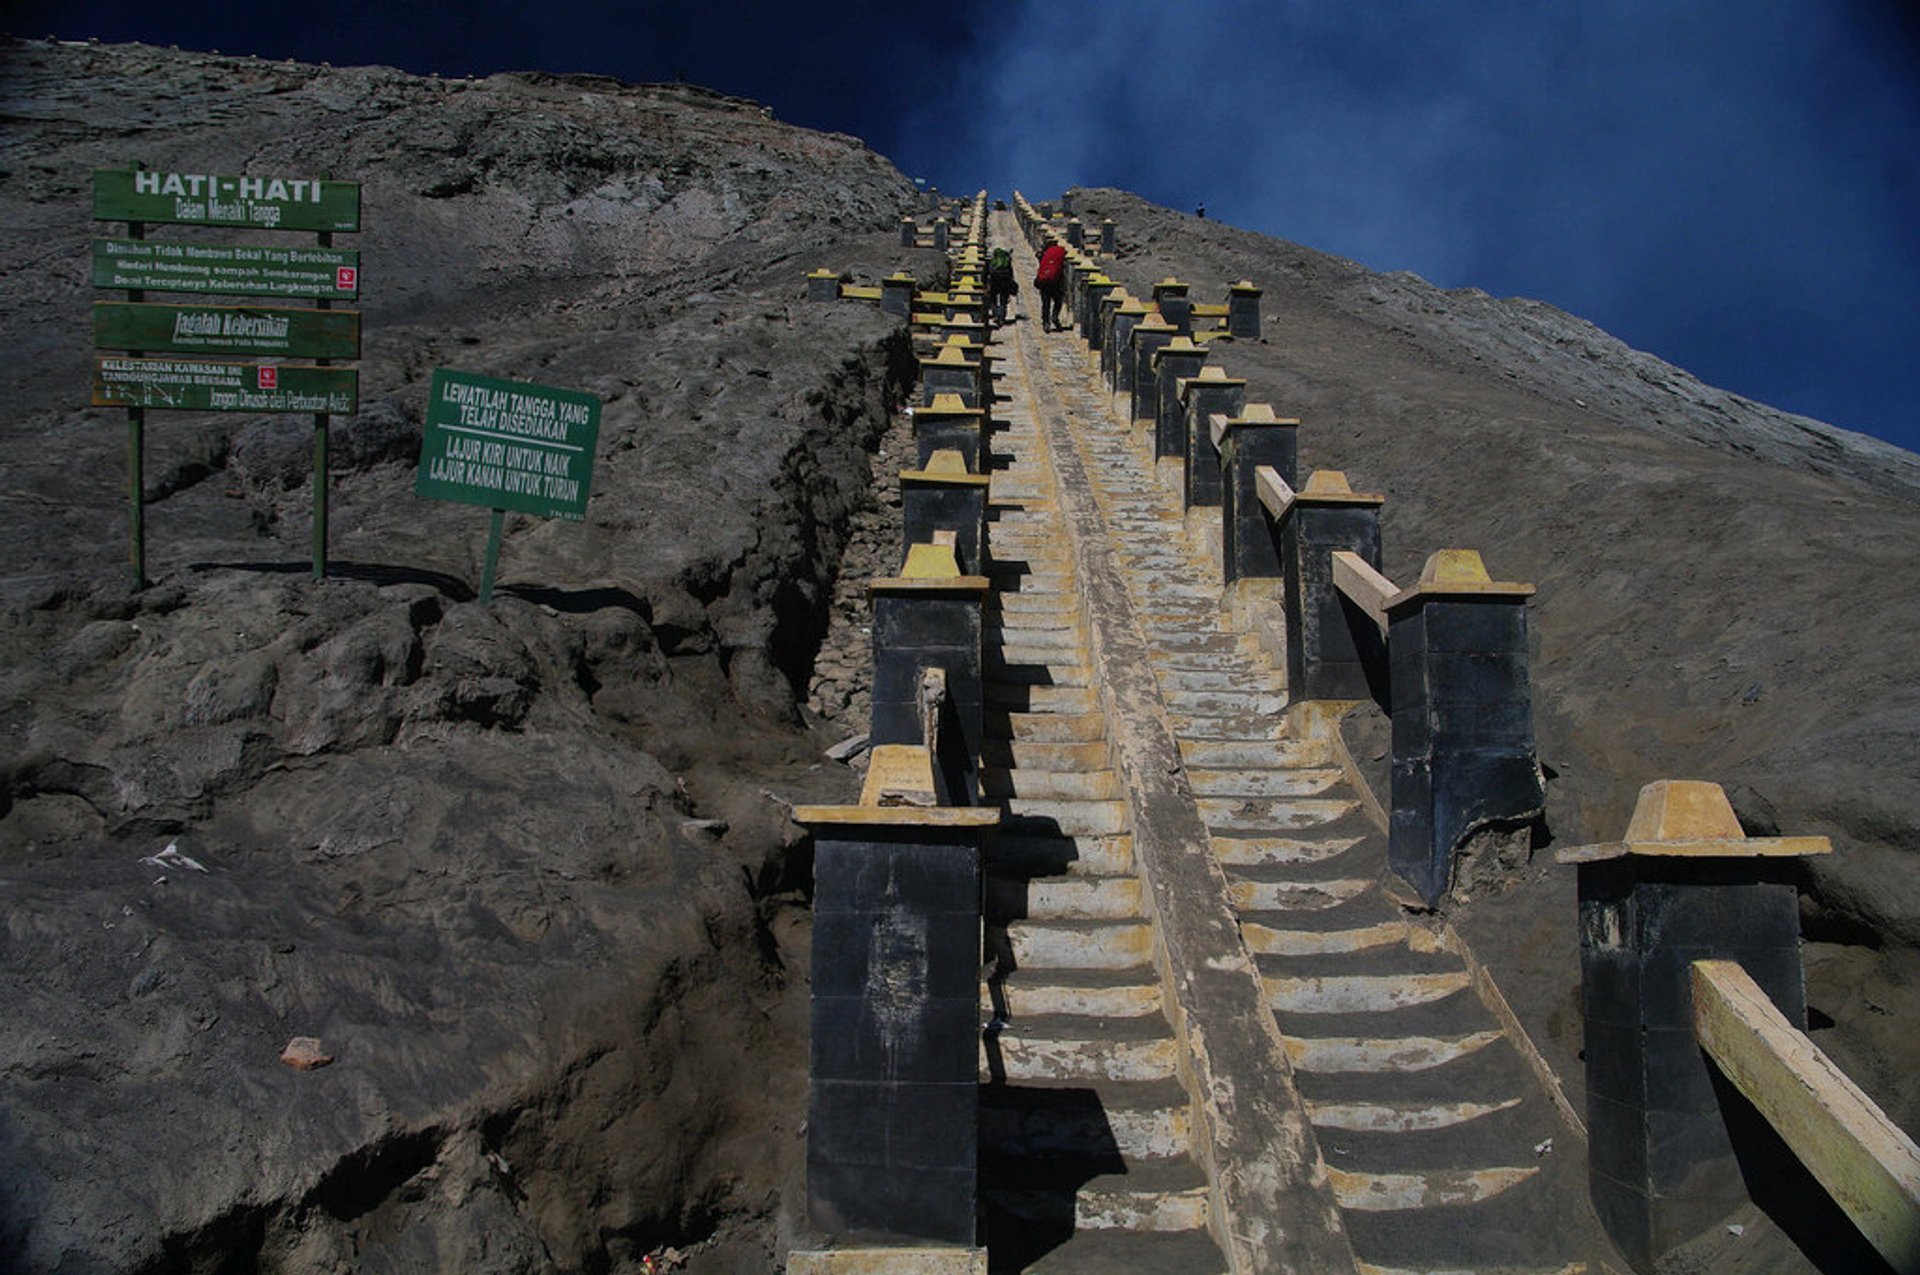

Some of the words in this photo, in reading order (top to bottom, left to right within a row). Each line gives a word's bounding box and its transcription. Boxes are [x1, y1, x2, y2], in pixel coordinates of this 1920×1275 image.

[134, 171, 321, 203] HATI-HATI
[175, 197, 205, 219] Dalam
[208, 198, 245, 221] Menaiki
[248, 200, 281, 227] Tangga
[173, 312, 221, 338] Jagalah
[223, 314, 288, 337] Kebersihan
[443, 382, 508, 411] LEWATILAH
[510, 394, 555, 418] TANGGA
[558, 402, 590, 425] YANG
[460, 405, 497, 428] TELAH
[499, 412, 569, 441] DISEDIAKAN
[446, 436, 481, 461] LAJUR
[482, 442, 506, 466] KIRI
[506, 445, 543, 471] UNTUK
[543, 453, 571, 477] NAIK
[429, 457, 466, 484] LAJUR
[466, 463, 505, 490] KANAN
[505, 469, 541, 496] UNTUK
[543, 477, 580, 502] TURUN
